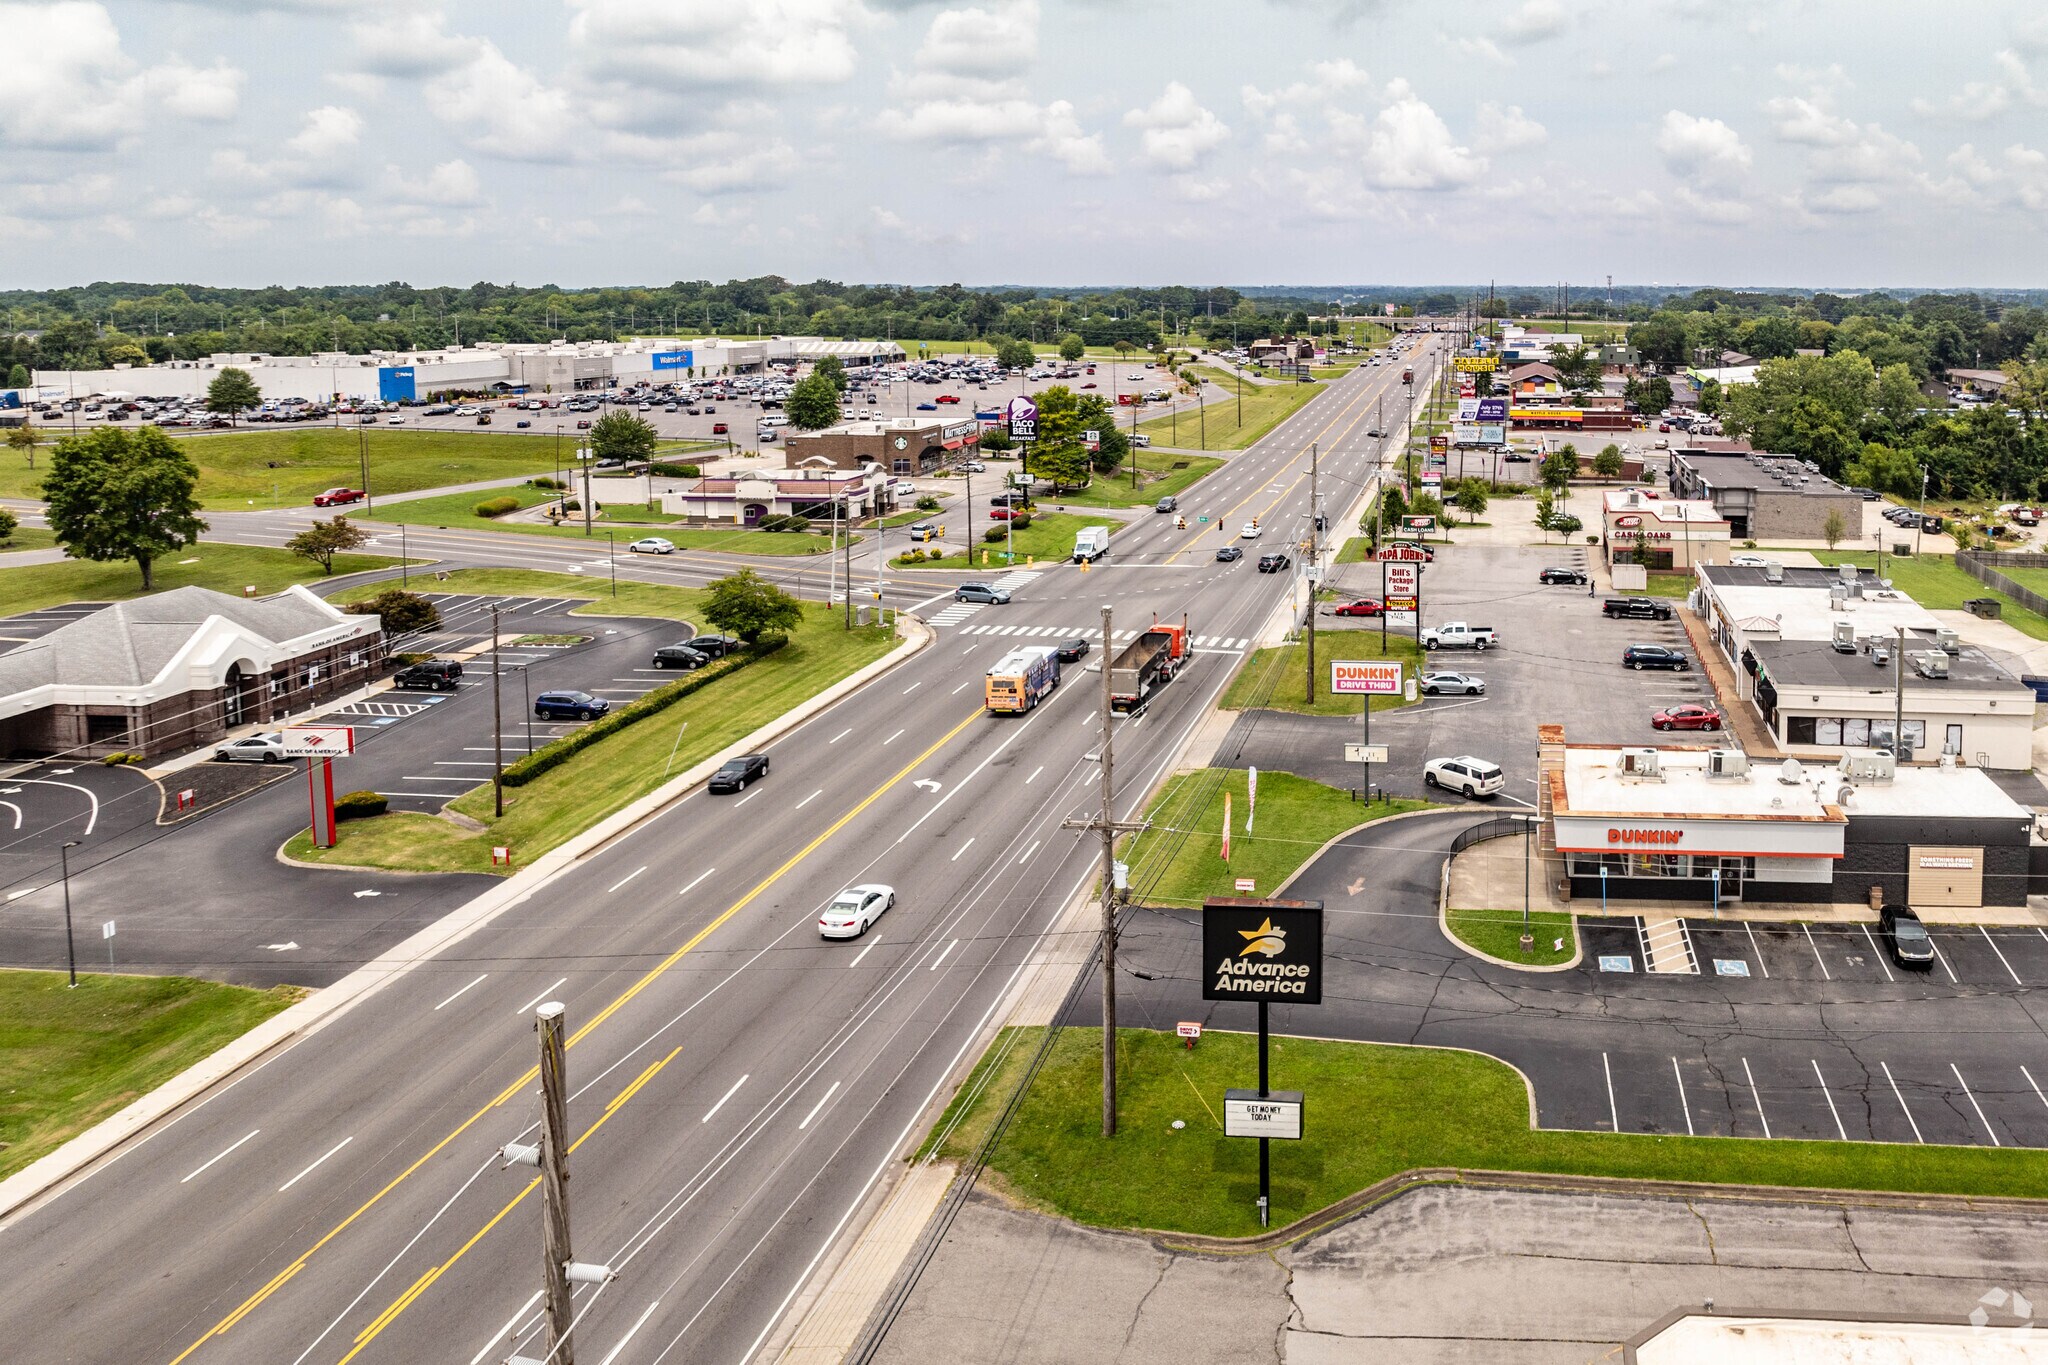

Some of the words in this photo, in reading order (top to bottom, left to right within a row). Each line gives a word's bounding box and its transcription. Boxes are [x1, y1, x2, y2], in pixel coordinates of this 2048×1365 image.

[660, 355, 682, 364] Walmart
[1012, 427, 1034, 435] BELL
[1615, 531, 1638, 539] CASH
[1379, 549, 1398, 560] PAPA
[1399, 549, 1424, 560] JOHNS
[1337, 667, 1399, 679] DUNKIN'
[1340, 681, 1366, 689] DRIVE
[1608, 829, 1683, 844] DUNKIN'
[1216, 958, 1310, 977] Advance
[1214, 974, 1306, 994] America
